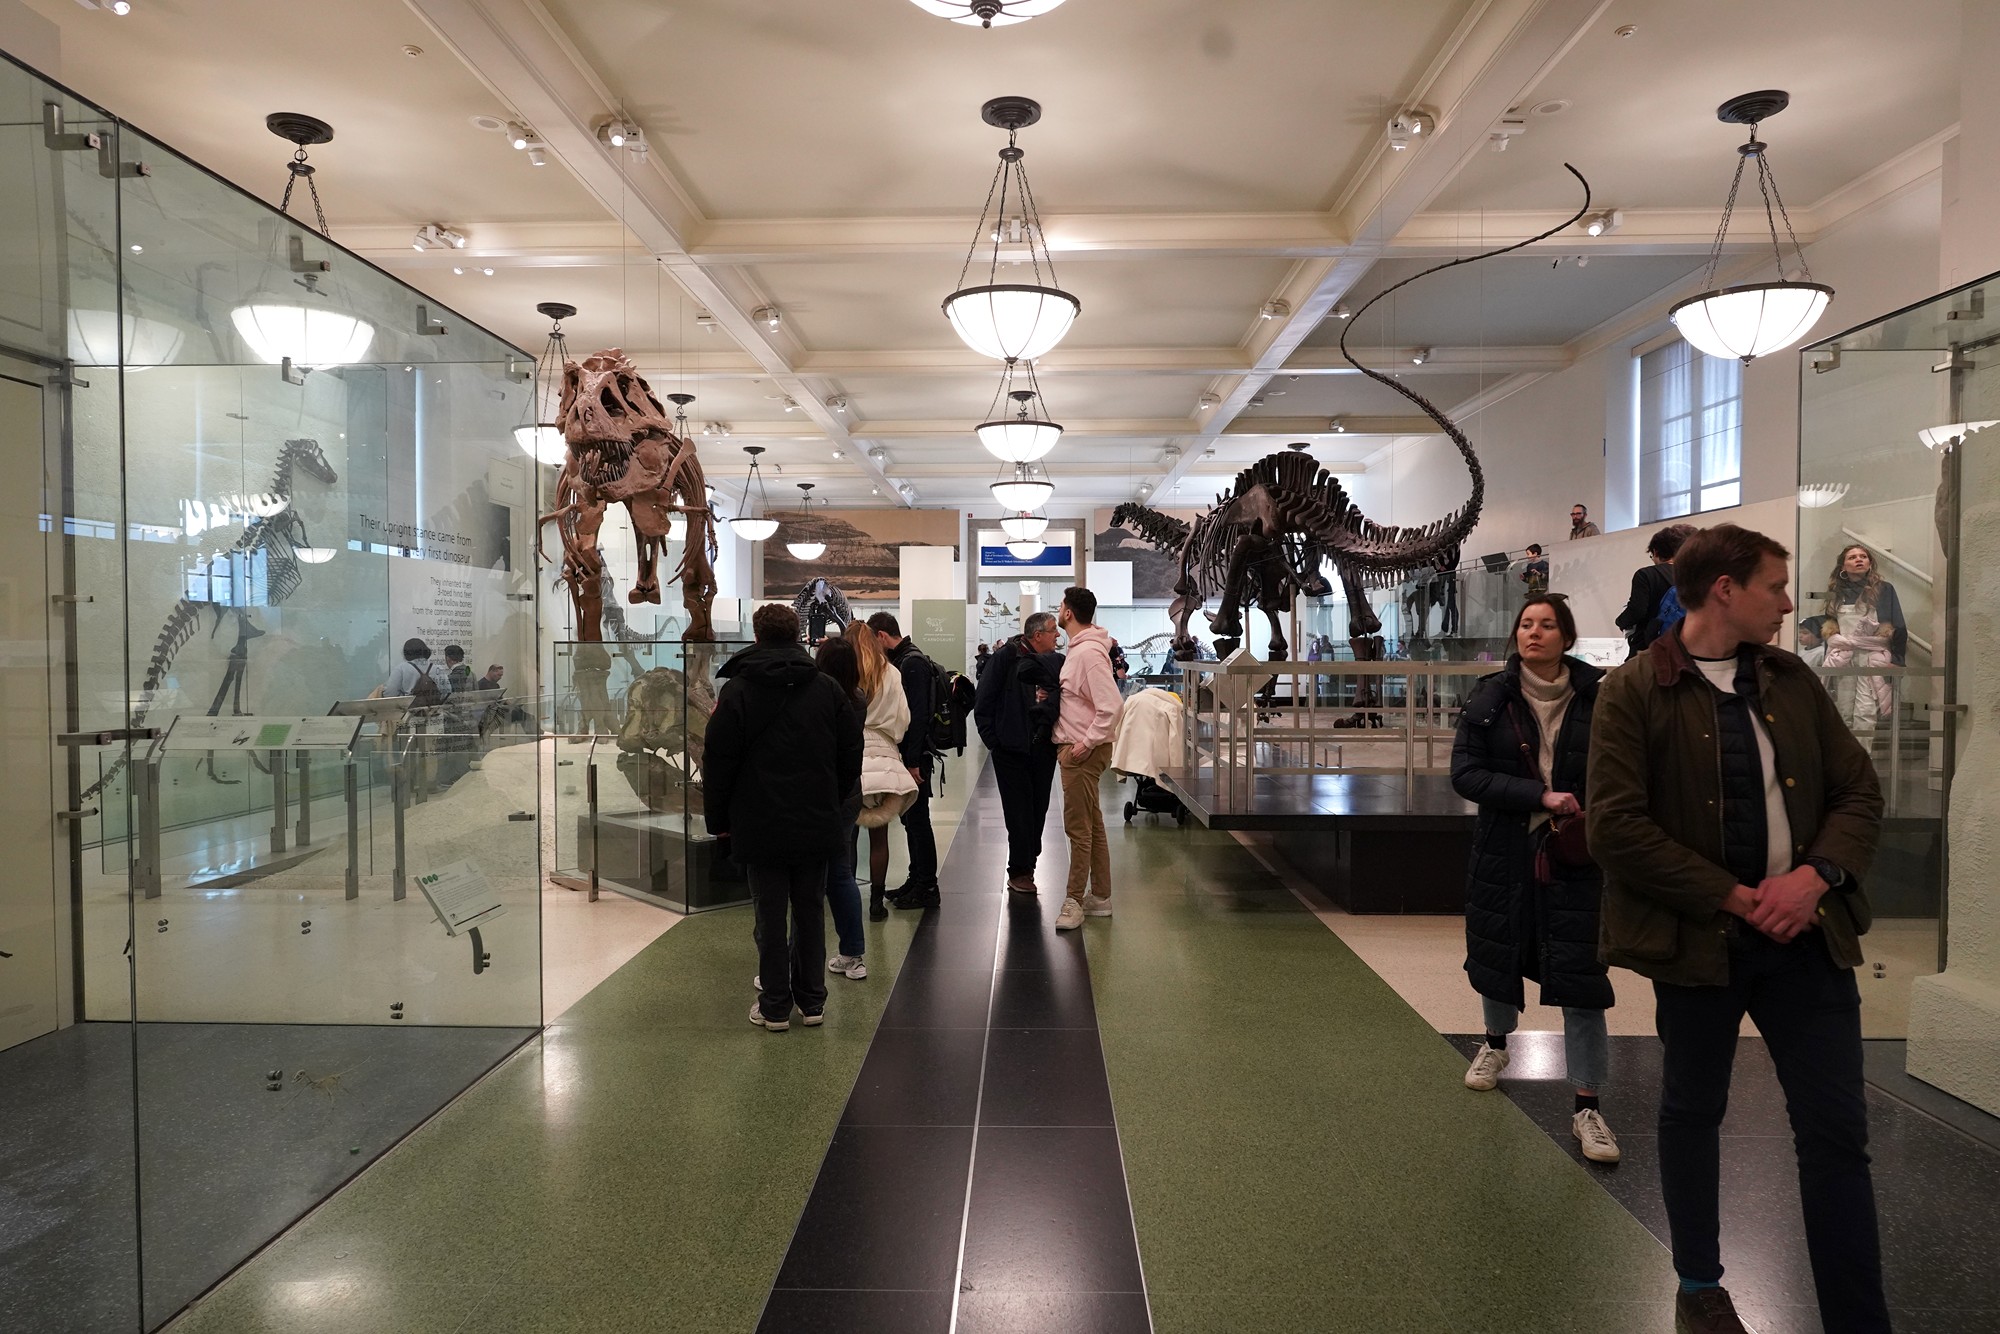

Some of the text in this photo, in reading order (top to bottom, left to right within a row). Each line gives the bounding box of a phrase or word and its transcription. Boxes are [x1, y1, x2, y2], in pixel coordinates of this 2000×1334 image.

[360, 514, 472, 547] Their upright stance came from
[428, 546, 442, 560] first
